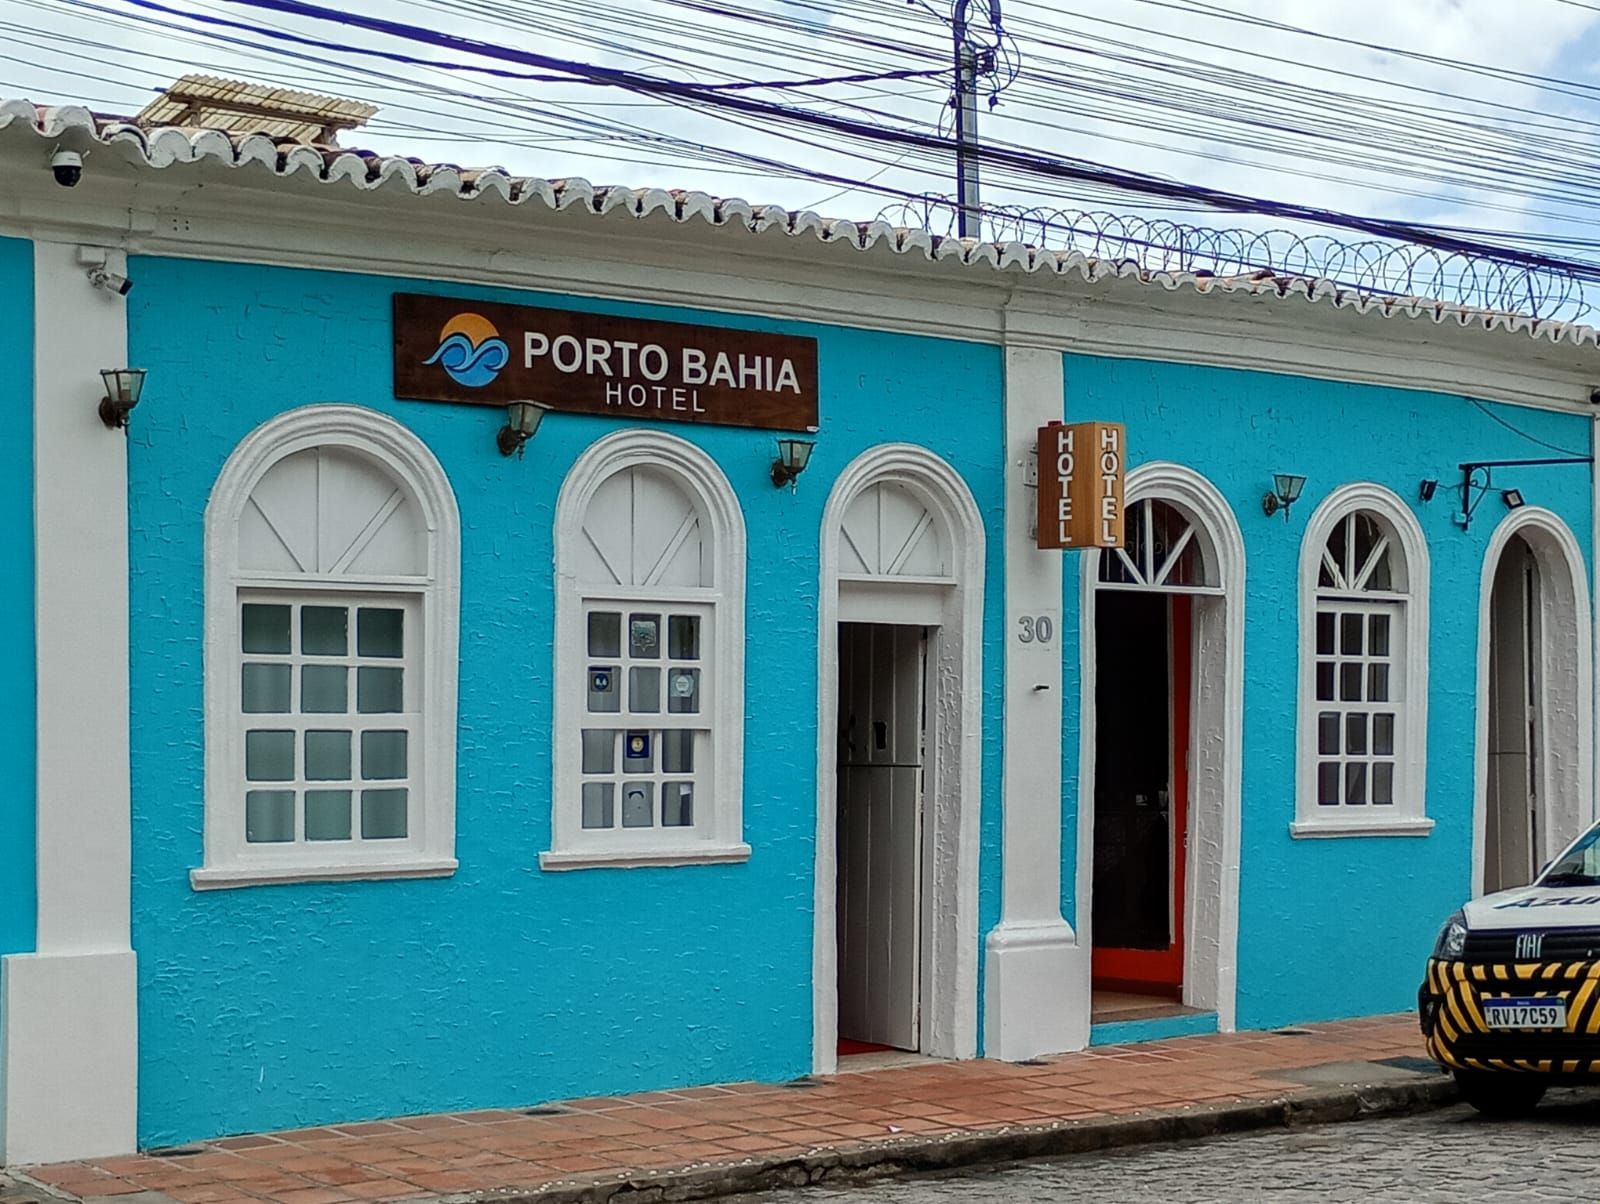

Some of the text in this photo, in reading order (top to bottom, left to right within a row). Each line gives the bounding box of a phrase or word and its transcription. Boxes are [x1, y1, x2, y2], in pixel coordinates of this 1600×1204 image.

[524, 331, 801, 394] PORTO BAHIA
[605, 382, 705, 412] HOTEL
[1057, 431, 1074, 543] HOTEL
[1101, 429, 1118, 543] HOTEL
[1018, 616, 1053, 643] 30
